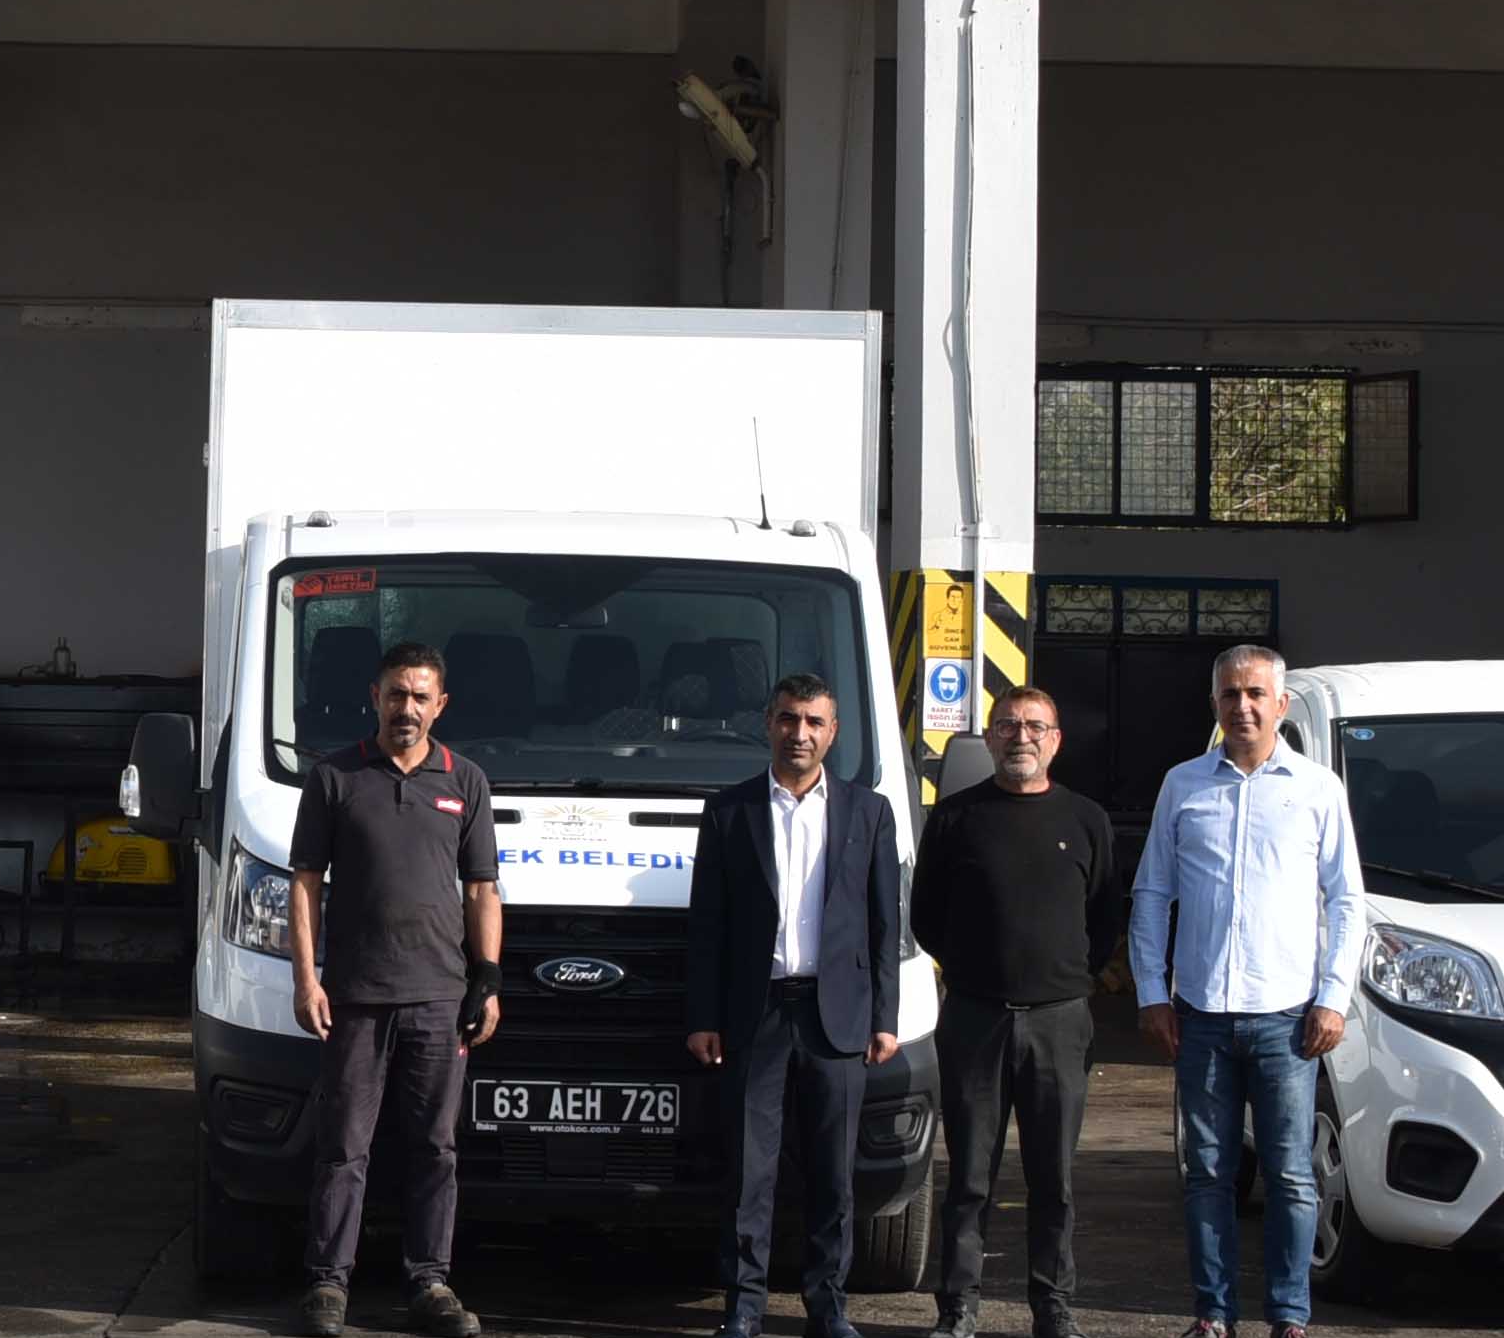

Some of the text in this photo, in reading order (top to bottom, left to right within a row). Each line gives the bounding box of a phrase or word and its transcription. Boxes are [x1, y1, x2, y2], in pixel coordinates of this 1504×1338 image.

[553, 962, 603, 981] Ford
[493, 1086, 675, 1122] 63 AEH 726
